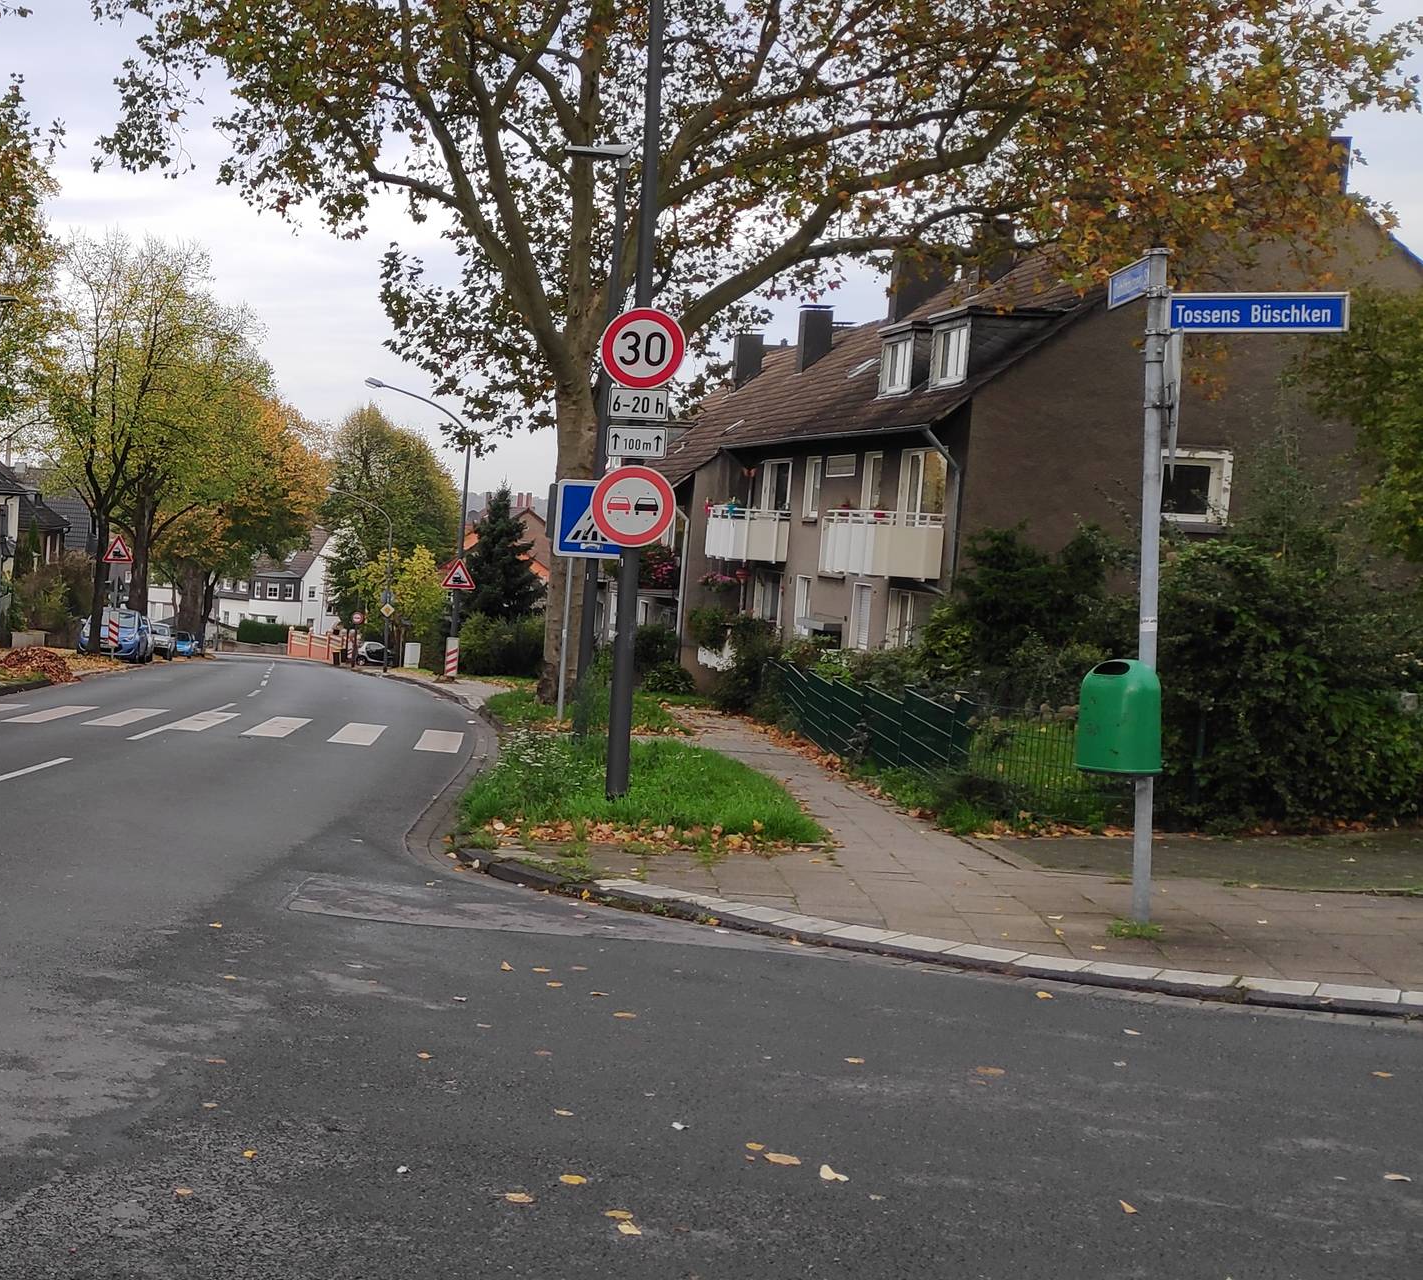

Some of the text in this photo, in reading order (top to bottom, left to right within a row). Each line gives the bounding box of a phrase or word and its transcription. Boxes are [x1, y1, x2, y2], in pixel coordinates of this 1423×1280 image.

[1176, 304, 1332, 324] Tossens Büschken
[619, 331, 667, 367] 30
[612, 395, 664, 414] 6-20 h
